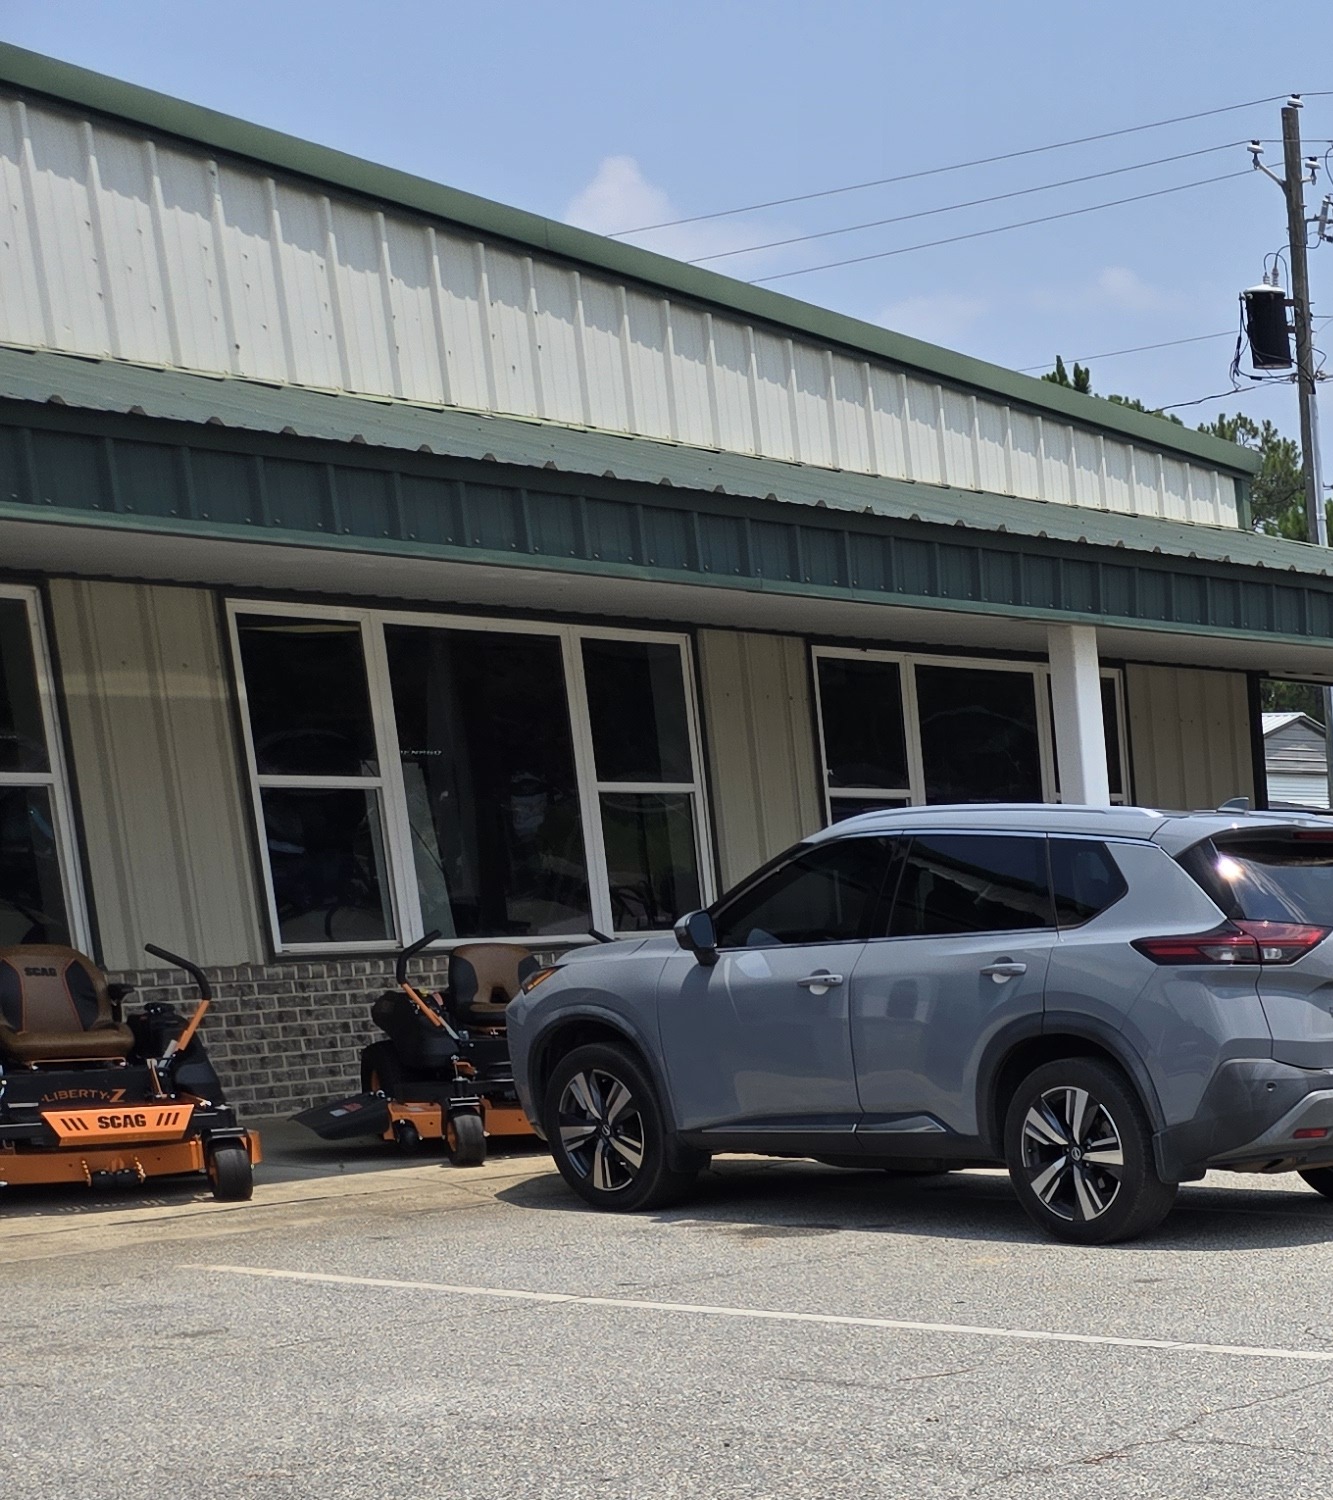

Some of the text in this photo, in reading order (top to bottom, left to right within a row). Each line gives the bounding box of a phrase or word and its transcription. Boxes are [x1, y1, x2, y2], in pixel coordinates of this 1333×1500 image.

[24, 967, 57, 977] SCAG
[44, 1088, 127, 1103] LIBERTY Z
[97, 1114, 147, 1129] SCAG
